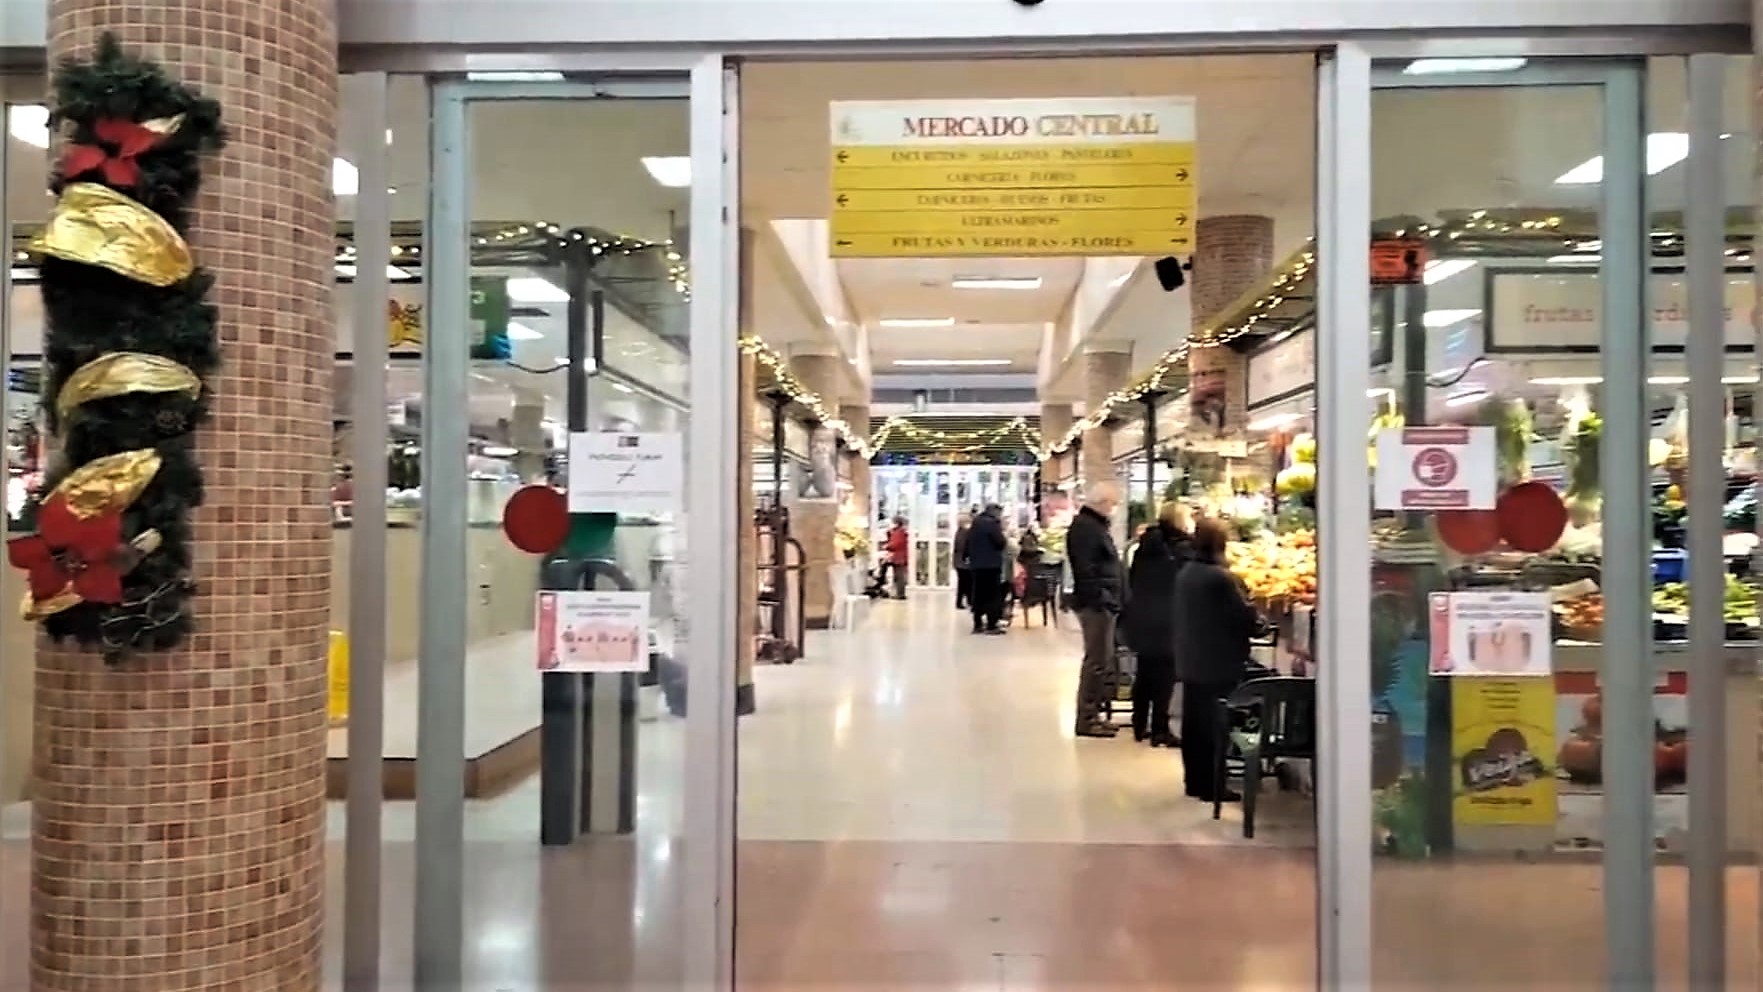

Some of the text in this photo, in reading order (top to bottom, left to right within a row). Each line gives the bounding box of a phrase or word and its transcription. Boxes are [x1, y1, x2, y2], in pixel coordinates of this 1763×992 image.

[903, 113, 1160, 138] MERCADO CENTRAL
[961, 215, 1059, 226] ULTRAMARINOS
[891, 236, 953, 247] FRUTAS
[970, 236, 1058, 247] VERDURAS
[1071, 236, 1134, 247] FLORES
[1523, 304, 1594, 323] frutas
